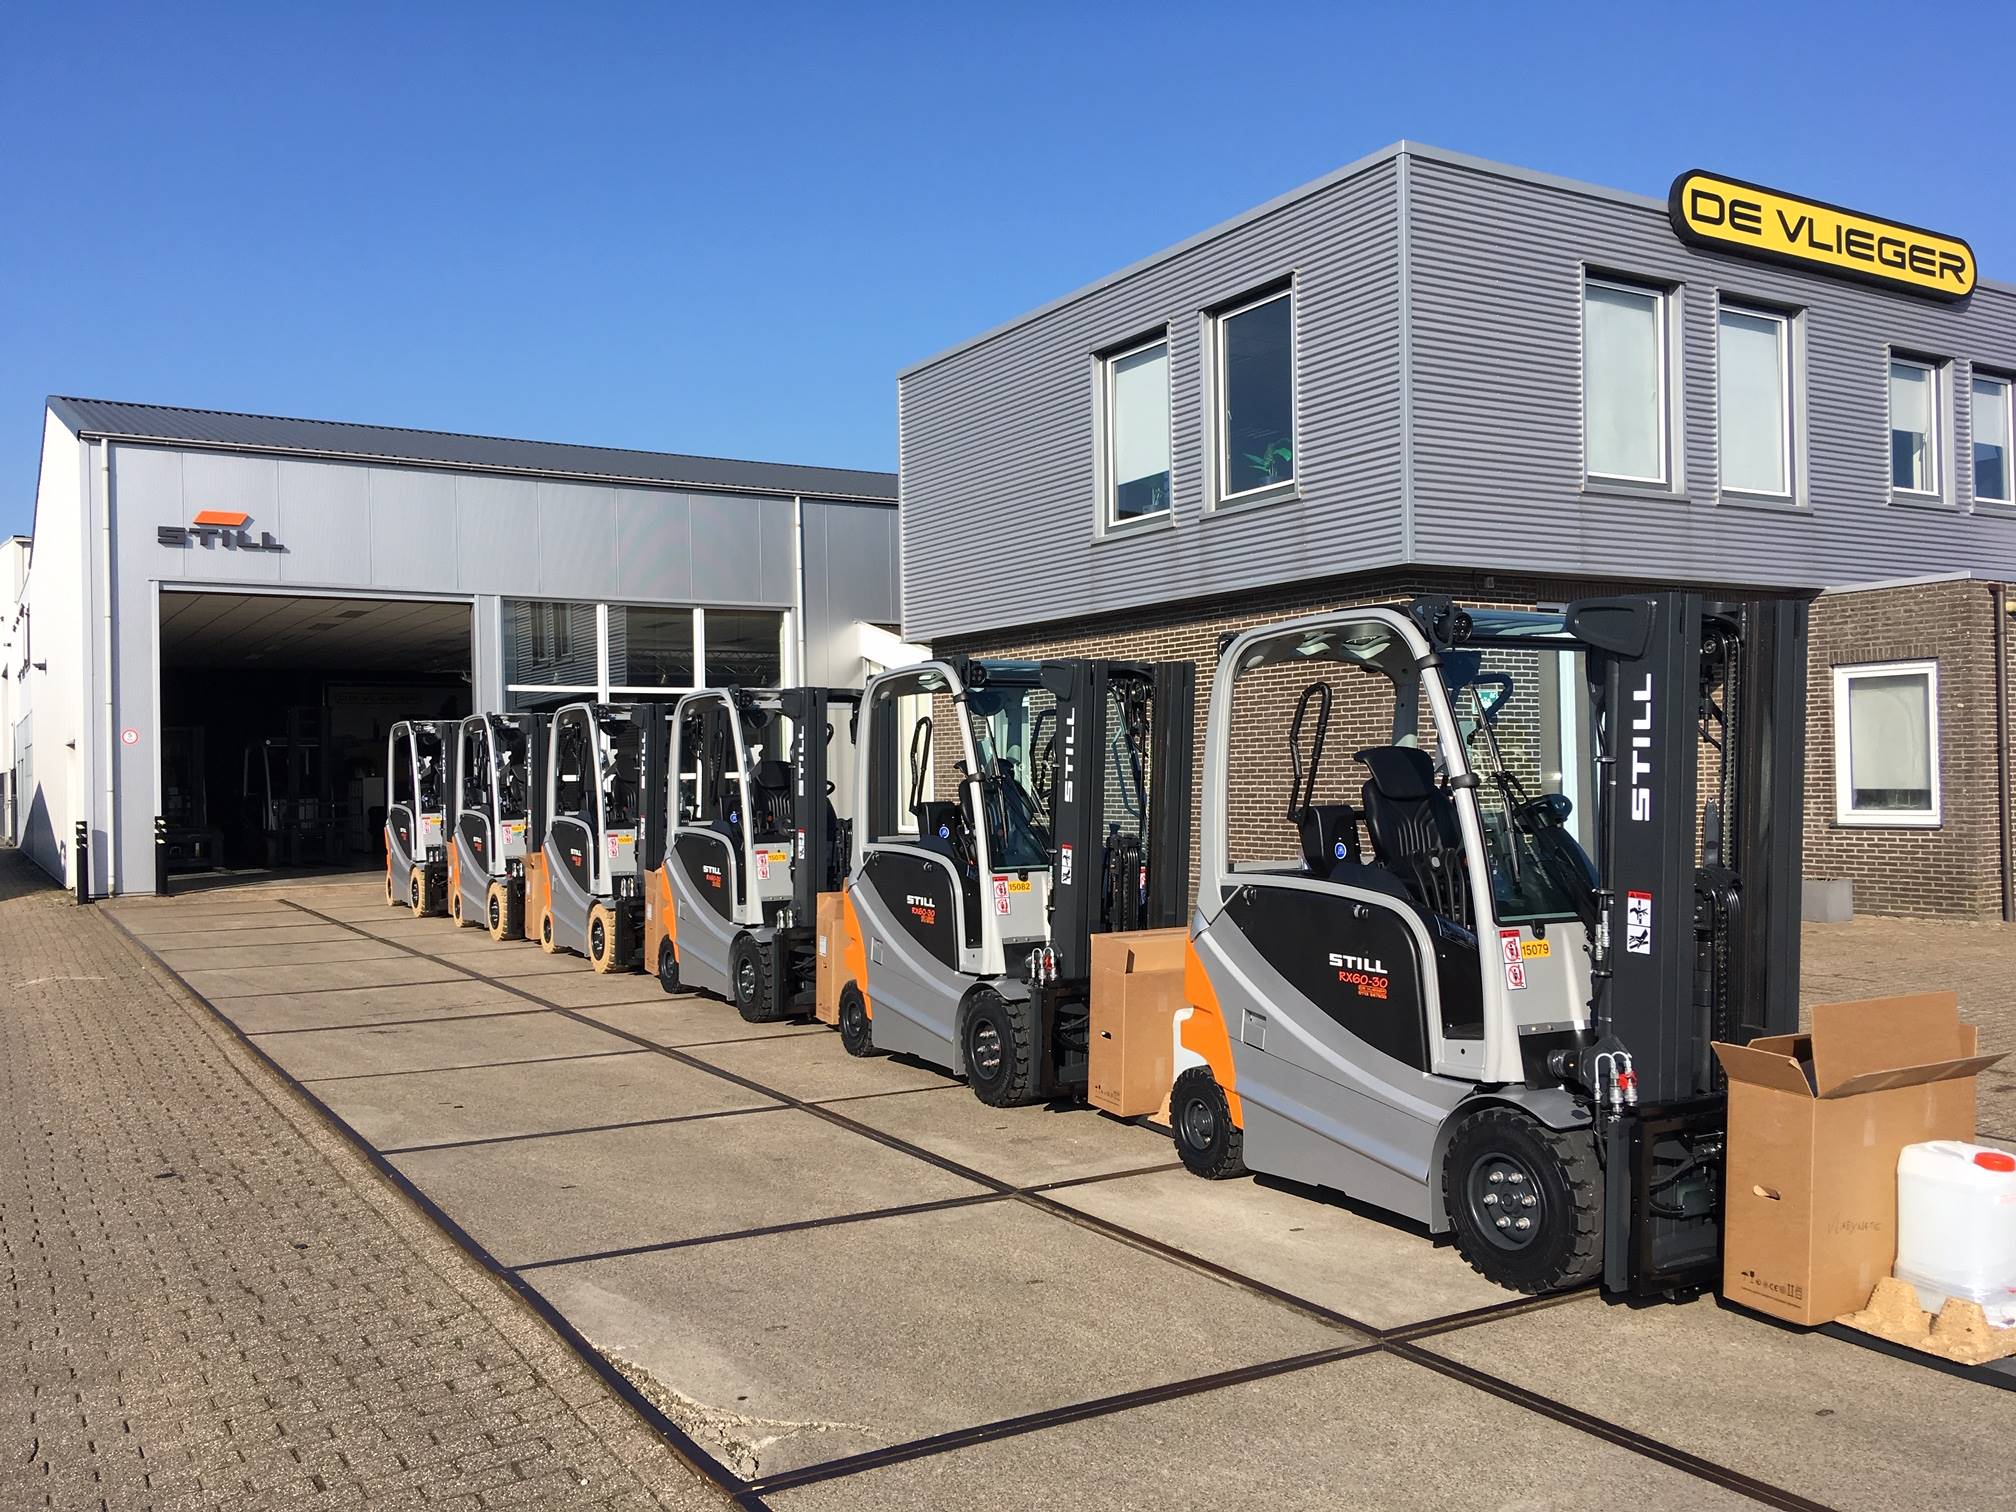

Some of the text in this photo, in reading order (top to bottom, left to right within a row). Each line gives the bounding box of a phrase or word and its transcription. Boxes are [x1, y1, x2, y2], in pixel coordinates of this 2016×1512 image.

[1691, 188, 1966, 285] DE VLIEGER
[157, 526, 284, 550] STILL
[1064, 707, 1075, 803] STILL
[1631, 673, 1652, 822] STILL
[703, 865, 721, 875] STILL
[906, 894, 935, 908] STILL
[1522, 943, 1549, 957] 15079
[1329, 952, 1388, 974] STILL
[1338, 970, 1388, 988] RX60-30
